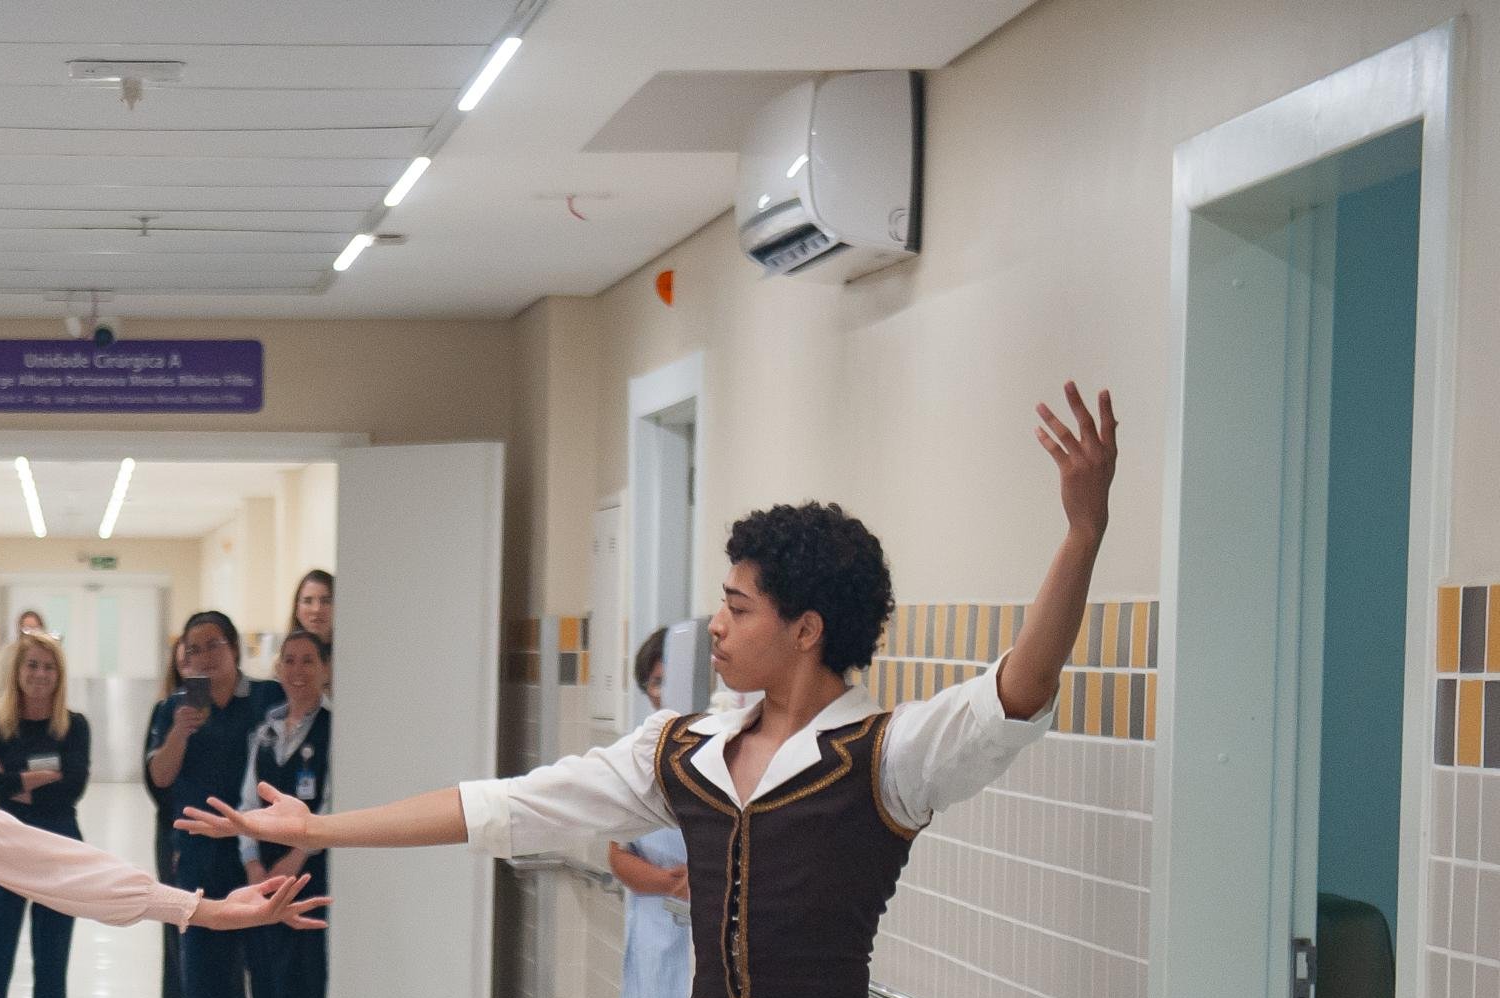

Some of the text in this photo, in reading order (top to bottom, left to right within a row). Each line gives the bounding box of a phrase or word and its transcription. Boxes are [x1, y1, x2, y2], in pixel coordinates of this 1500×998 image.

[24, 353, 181, 373] Unidade Cirúrgica A
[19, 375, 62, 386] Alberto
